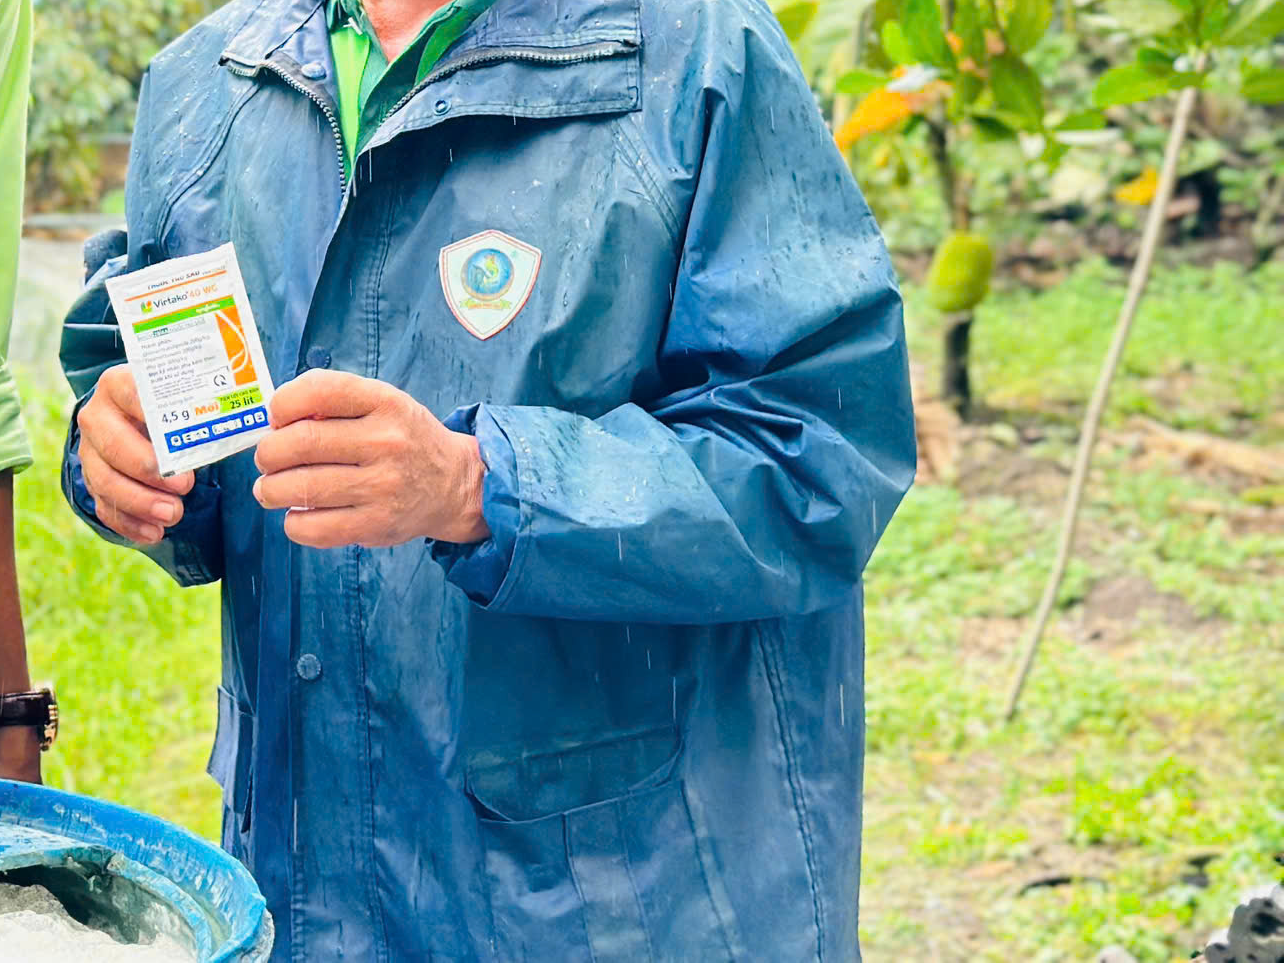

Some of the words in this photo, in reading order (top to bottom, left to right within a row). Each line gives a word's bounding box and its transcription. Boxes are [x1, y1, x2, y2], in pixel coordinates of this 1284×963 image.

[152, 291, 188, 308] Virtako
[229, 398, 241, 409] 25
[161, 411, 179, 424] 4,5
[182, 408, 190, 420] g
